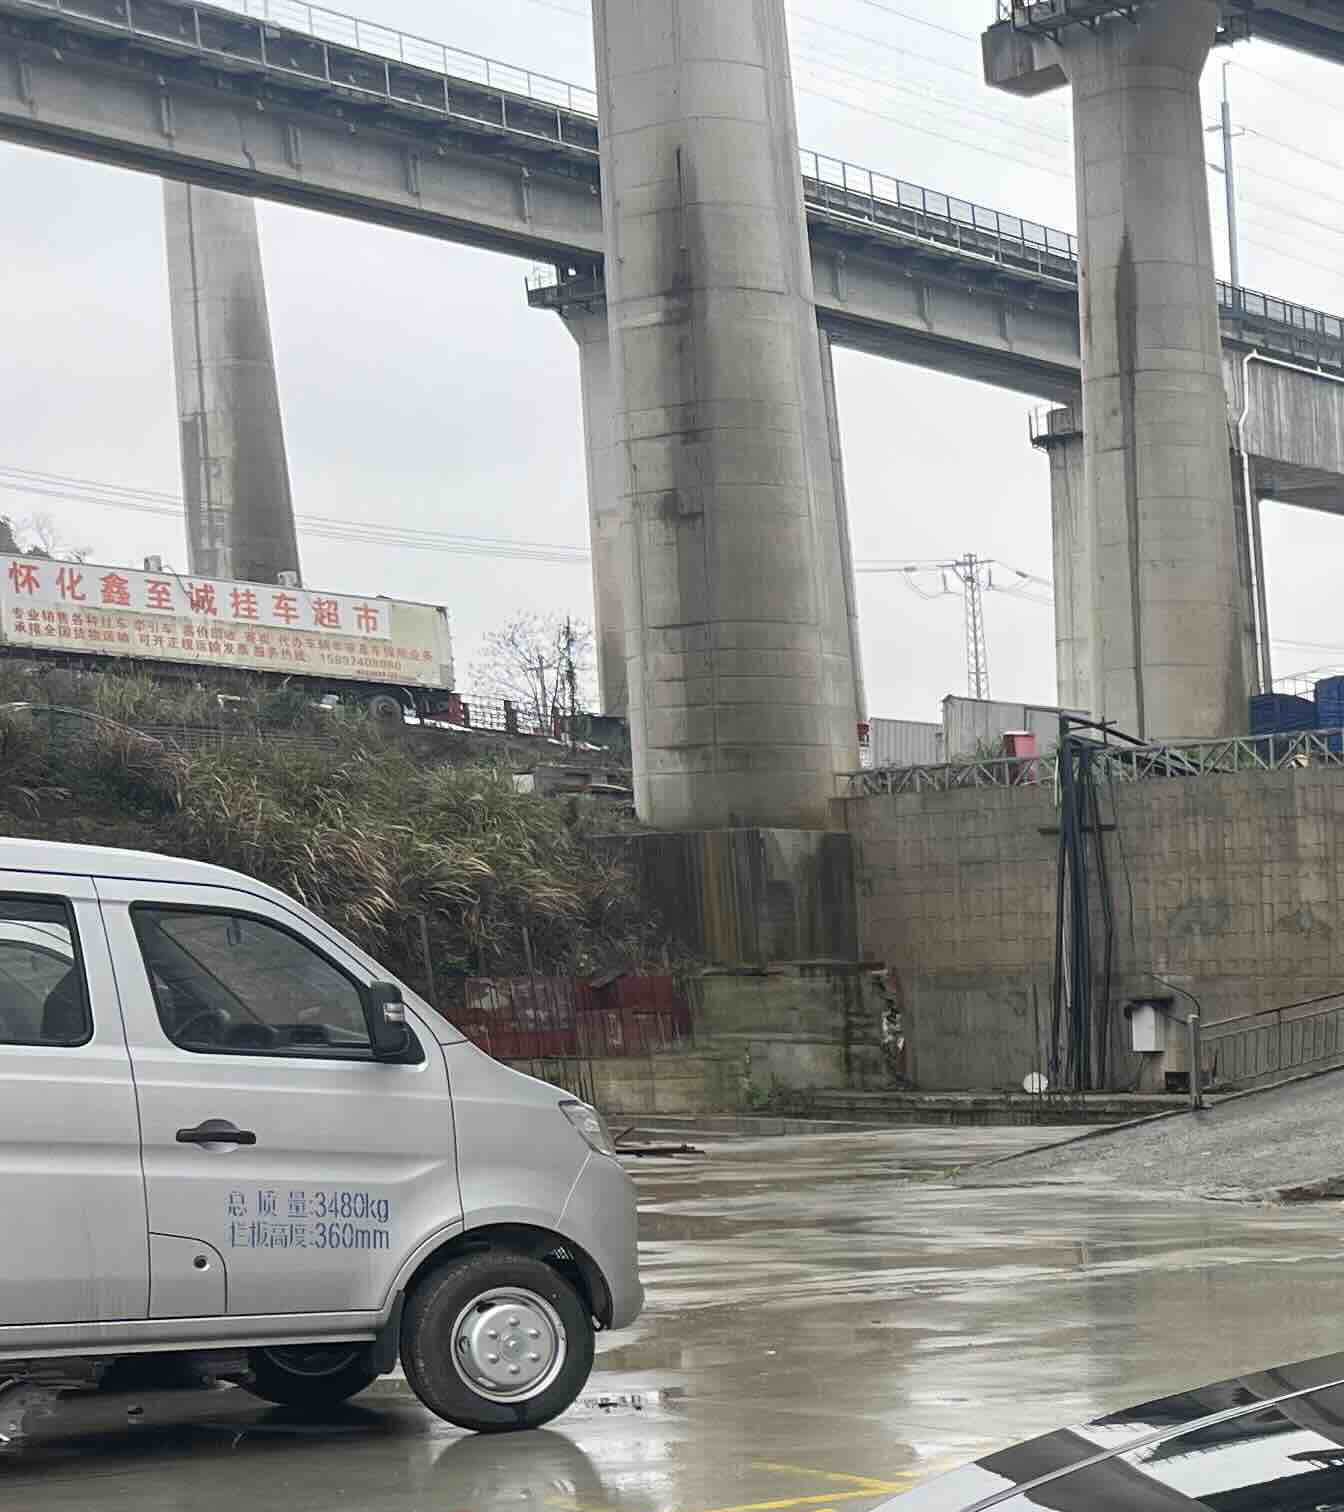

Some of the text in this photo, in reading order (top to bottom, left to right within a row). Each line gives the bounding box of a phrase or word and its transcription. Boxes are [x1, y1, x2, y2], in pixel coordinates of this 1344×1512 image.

[8, 560, 380, 634] 怀化鑫至诚挂车超市
